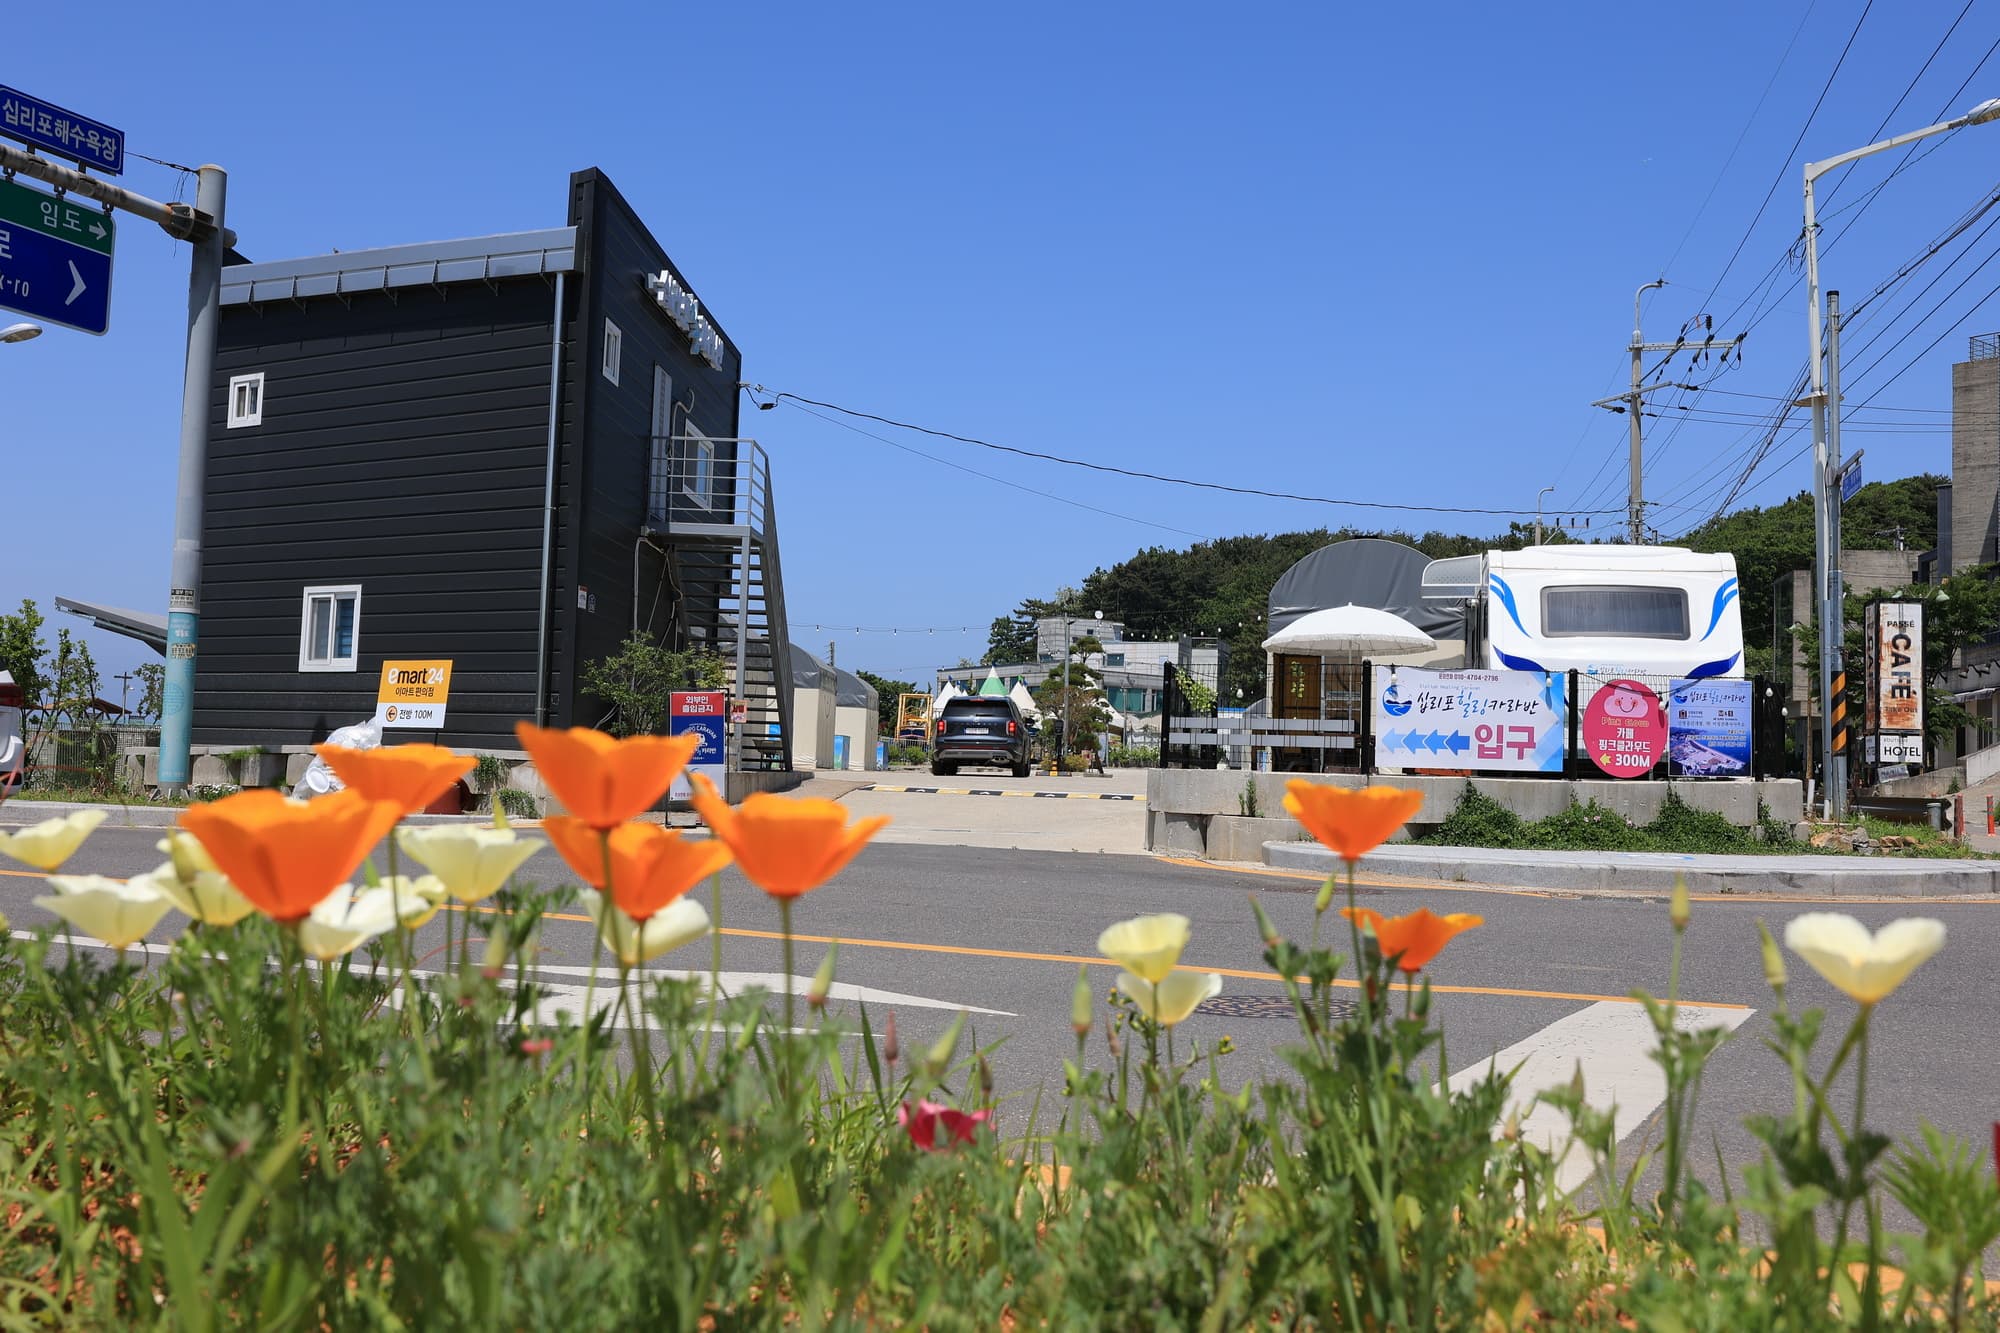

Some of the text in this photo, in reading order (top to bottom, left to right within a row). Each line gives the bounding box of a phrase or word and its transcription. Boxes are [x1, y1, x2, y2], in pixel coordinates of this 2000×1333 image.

[2, 98, 117, 162] 십리포해수욕장
[1891, 633, 1917, 699] CAFÉ
[388, 667, 444, 685] emart24
[685, 695, 709, 704] 외부인
[399, 709, 433, 720] 전방 100M
[682, 704, 714, 713] 출입금지
[1616, 728, 1634, 739] 카페
[1474, 724, 1537, 760] 입구
[1599, 739, 1651, 752] 핑크클라우드
[1884, 746, 1921, 757] HOTEL
[1615, 754, 1650, 767] 300M
